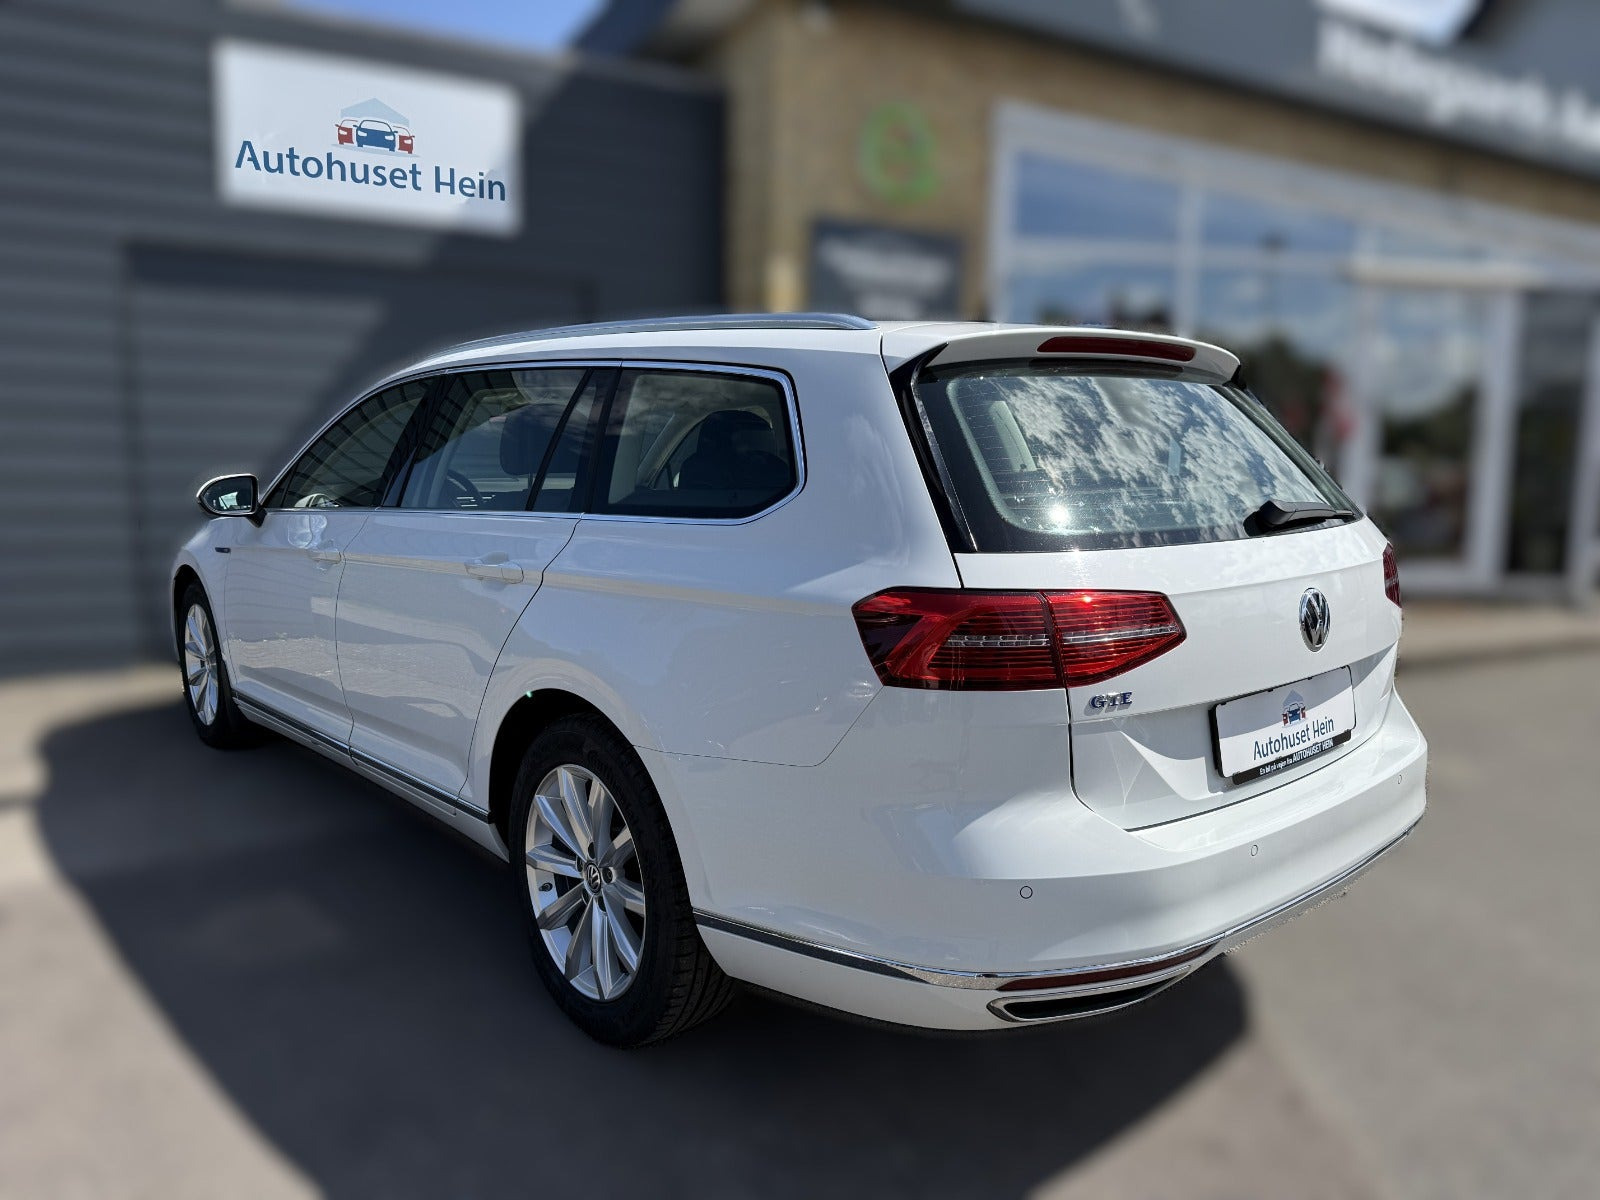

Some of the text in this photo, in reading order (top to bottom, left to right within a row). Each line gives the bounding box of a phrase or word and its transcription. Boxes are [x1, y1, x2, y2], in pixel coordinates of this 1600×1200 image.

[235, 140, 506, 201] Autohuset Hein
[1090, 691, 1133, 708] GTE
[1253, 716, 1335, 761] Autohuset Hein
[1292, 742, 1322, 763] AUTOHUSET
[1321, 738, 1334, 750] HEIN
